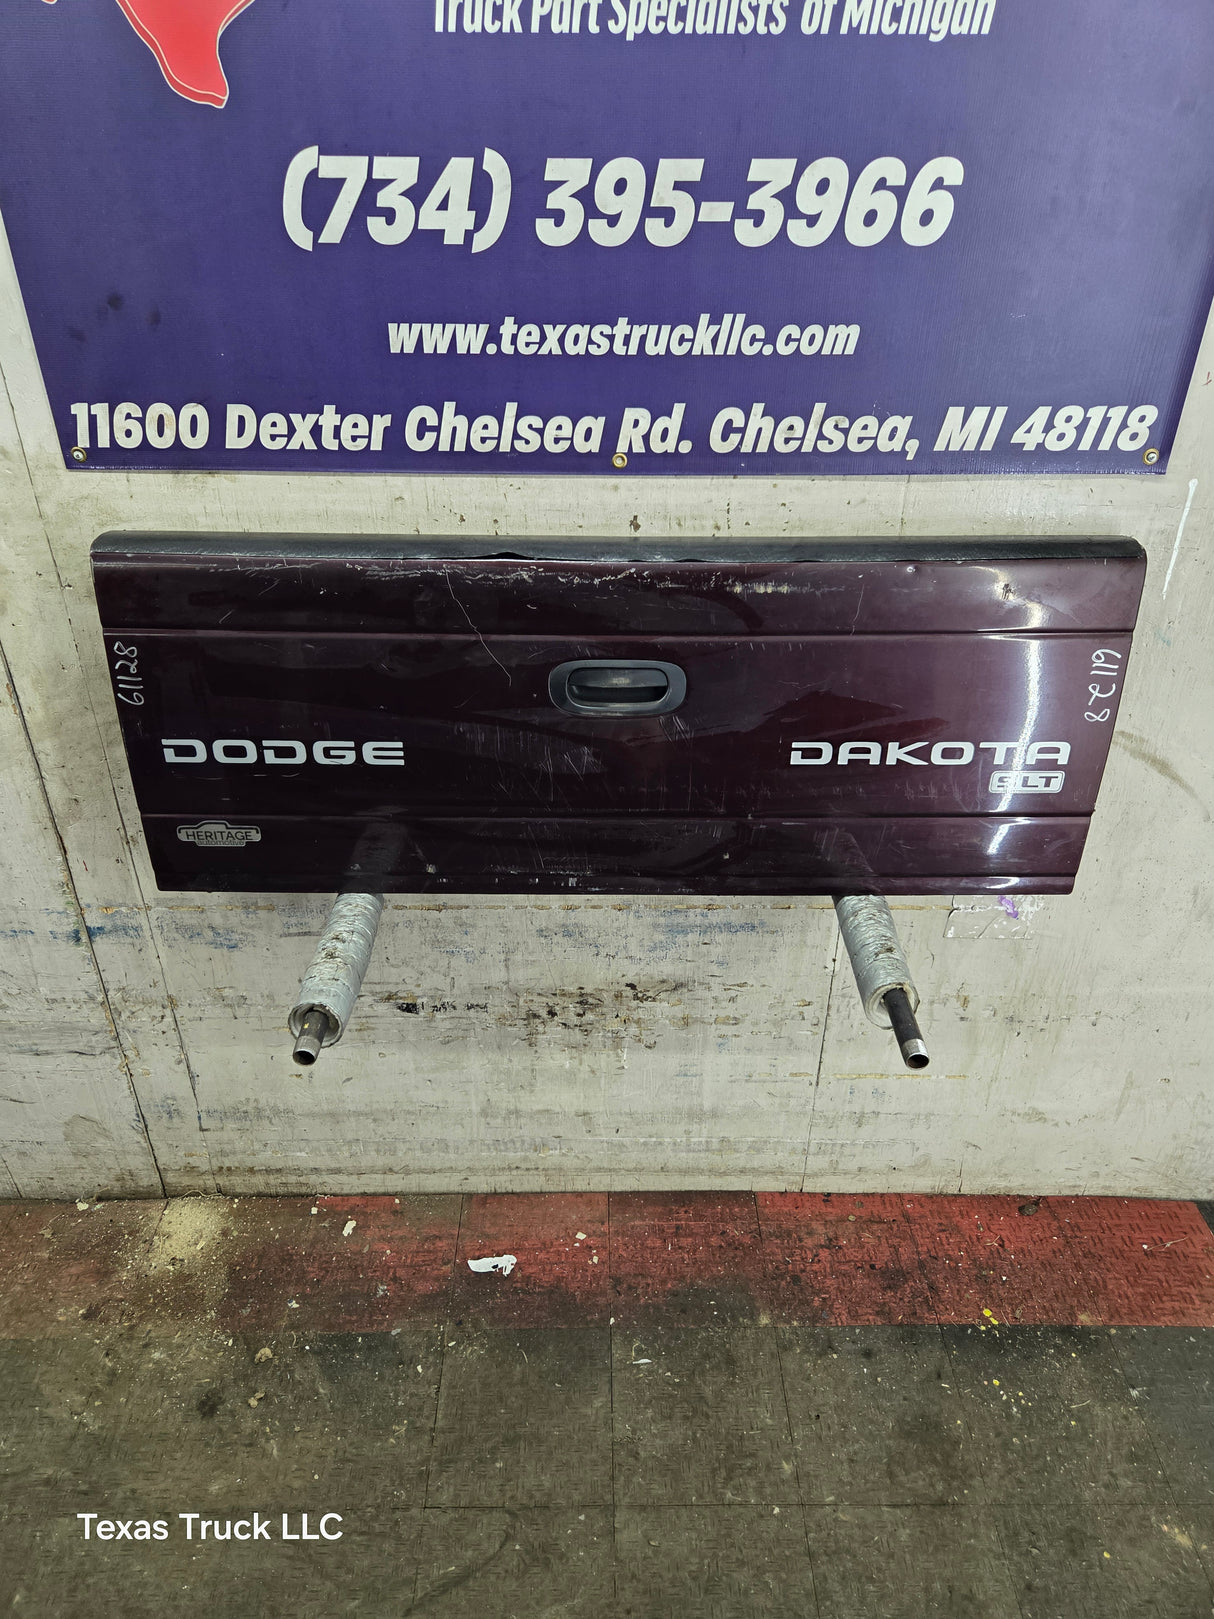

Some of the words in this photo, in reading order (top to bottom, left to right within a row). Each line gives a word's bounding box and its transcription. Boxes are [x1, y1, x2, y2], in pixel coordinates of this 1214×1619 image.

[434, 0, 523, 33] Truck
[530, 0, 603, 33] Part
[607, 0, 790, 41] Specialists
[800, 0, 838, 35] of
[839, 0, 997, 42] Michigan
[282, 146, 512, 253] (734)
[535, 156, 965, 248] 395-3966
[387, 313, 861, 356] www.texastruckllc.com
[70, 402, 210, 449] 11600
[225, 403, 392, 451] Dexter
[404, 401, 605, 453] Chelsea
[615, 402, 692, 454] Rd.
[709, 402, 920, 461] Chelsea,
[933, 406, 1009, 452] MI
[1010, 404, 1158, 452] 48118
[113, 641, 145, 706] 61128
[1084, 648, 1122, 722] 61128
[161, 738, 405, 766] DODGE
[789, 741, 1072, 766] DAKOTA
[996, 775, 1059, 788] SLT
[184, 830, 254, 841] HERITAGE
